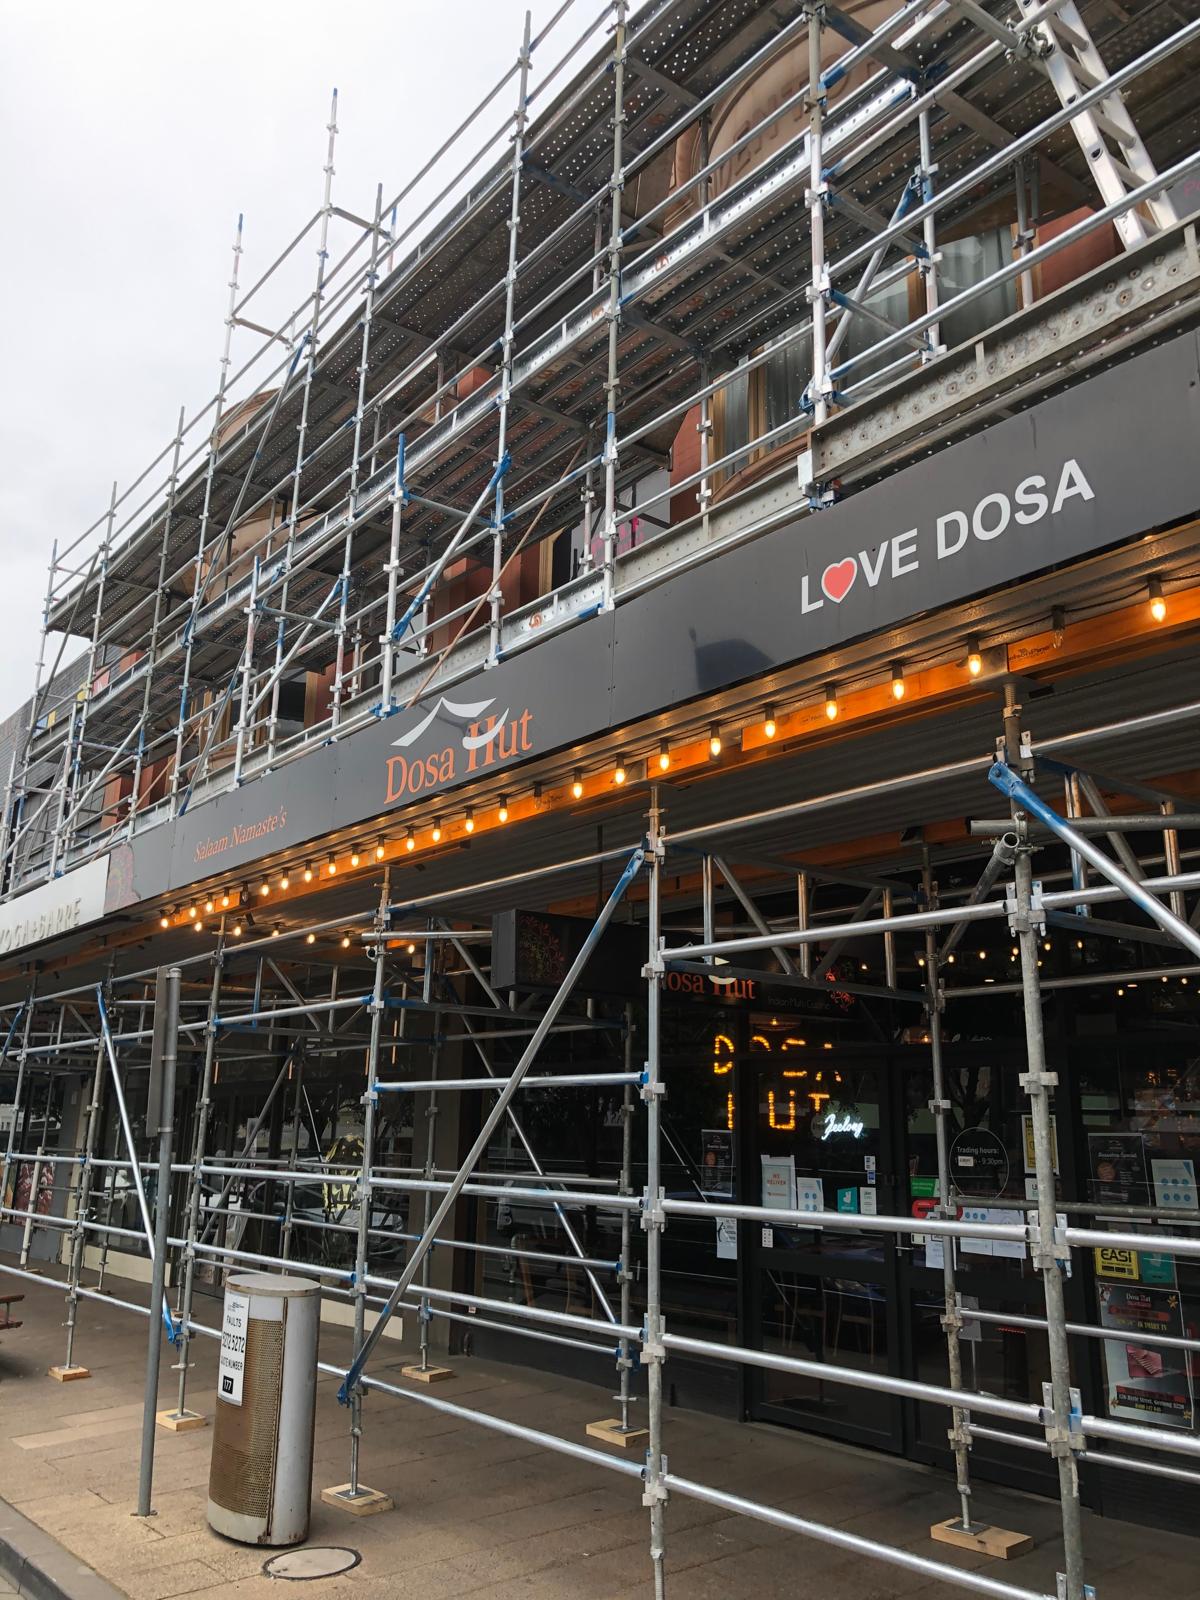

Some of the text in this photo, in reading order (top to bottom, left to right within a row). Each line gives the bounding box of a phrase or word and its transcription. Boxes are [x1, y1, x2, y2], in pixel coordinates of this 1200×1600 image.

[936, 458, 1095, 560] DOSA
[383, 708, 534, 805] Dosa Hut
[193, 805, 288, 864] Salaam Namaste's
[662, 970, 705, 995] osa
[1100, 1248, 1132, 1263] EASI
[226, 1314, 242, 1328] FAULTS
